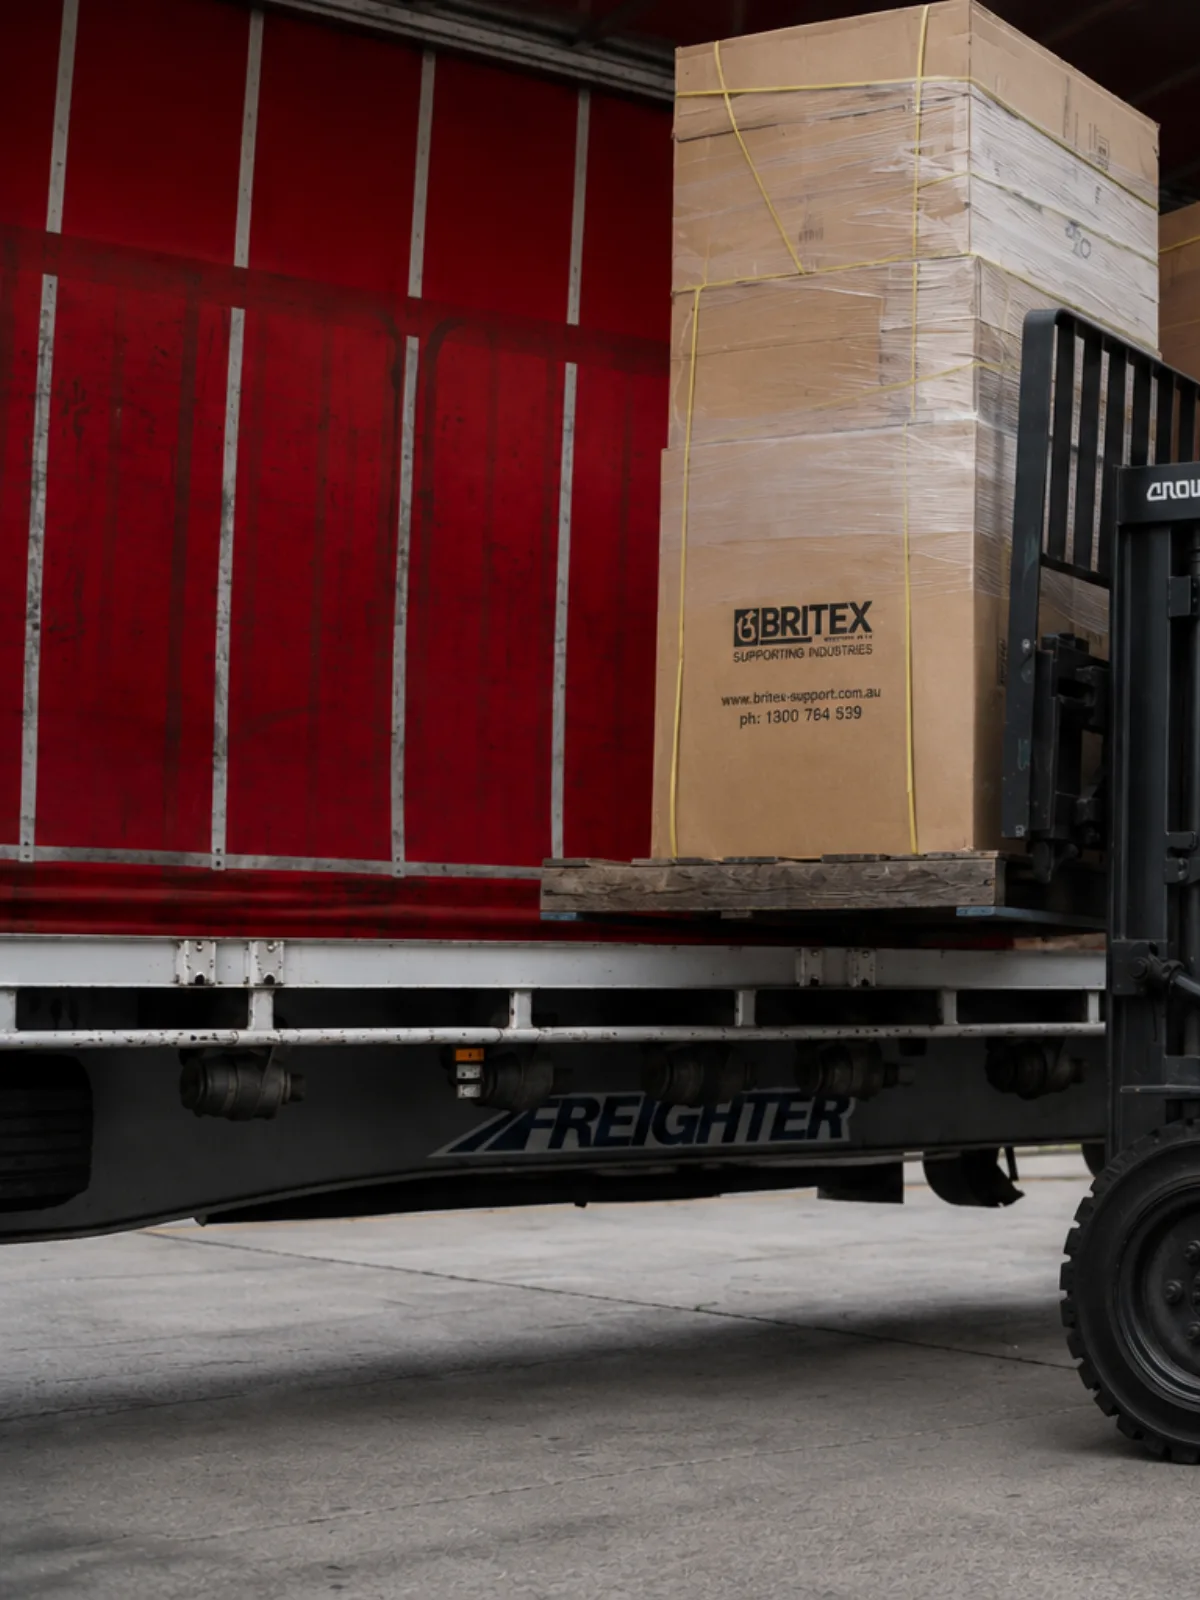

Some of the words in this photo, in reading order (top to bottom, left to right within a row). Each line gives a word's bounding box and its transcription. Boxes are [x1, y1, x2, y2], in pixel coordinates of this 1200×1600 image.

[760, 600, 873, 638] BRITEX
[733, 646, 805, 663] SUPPORTING
[808, 643, 873, 658] INDUSTRIES
[720, 688, 881, 706] www.britex-support.com.au
[739, 711, 761, 729] ph:
[766, 708, 799, 724] 1300
[484, 1091, 850, 1151] FREIGHTER
